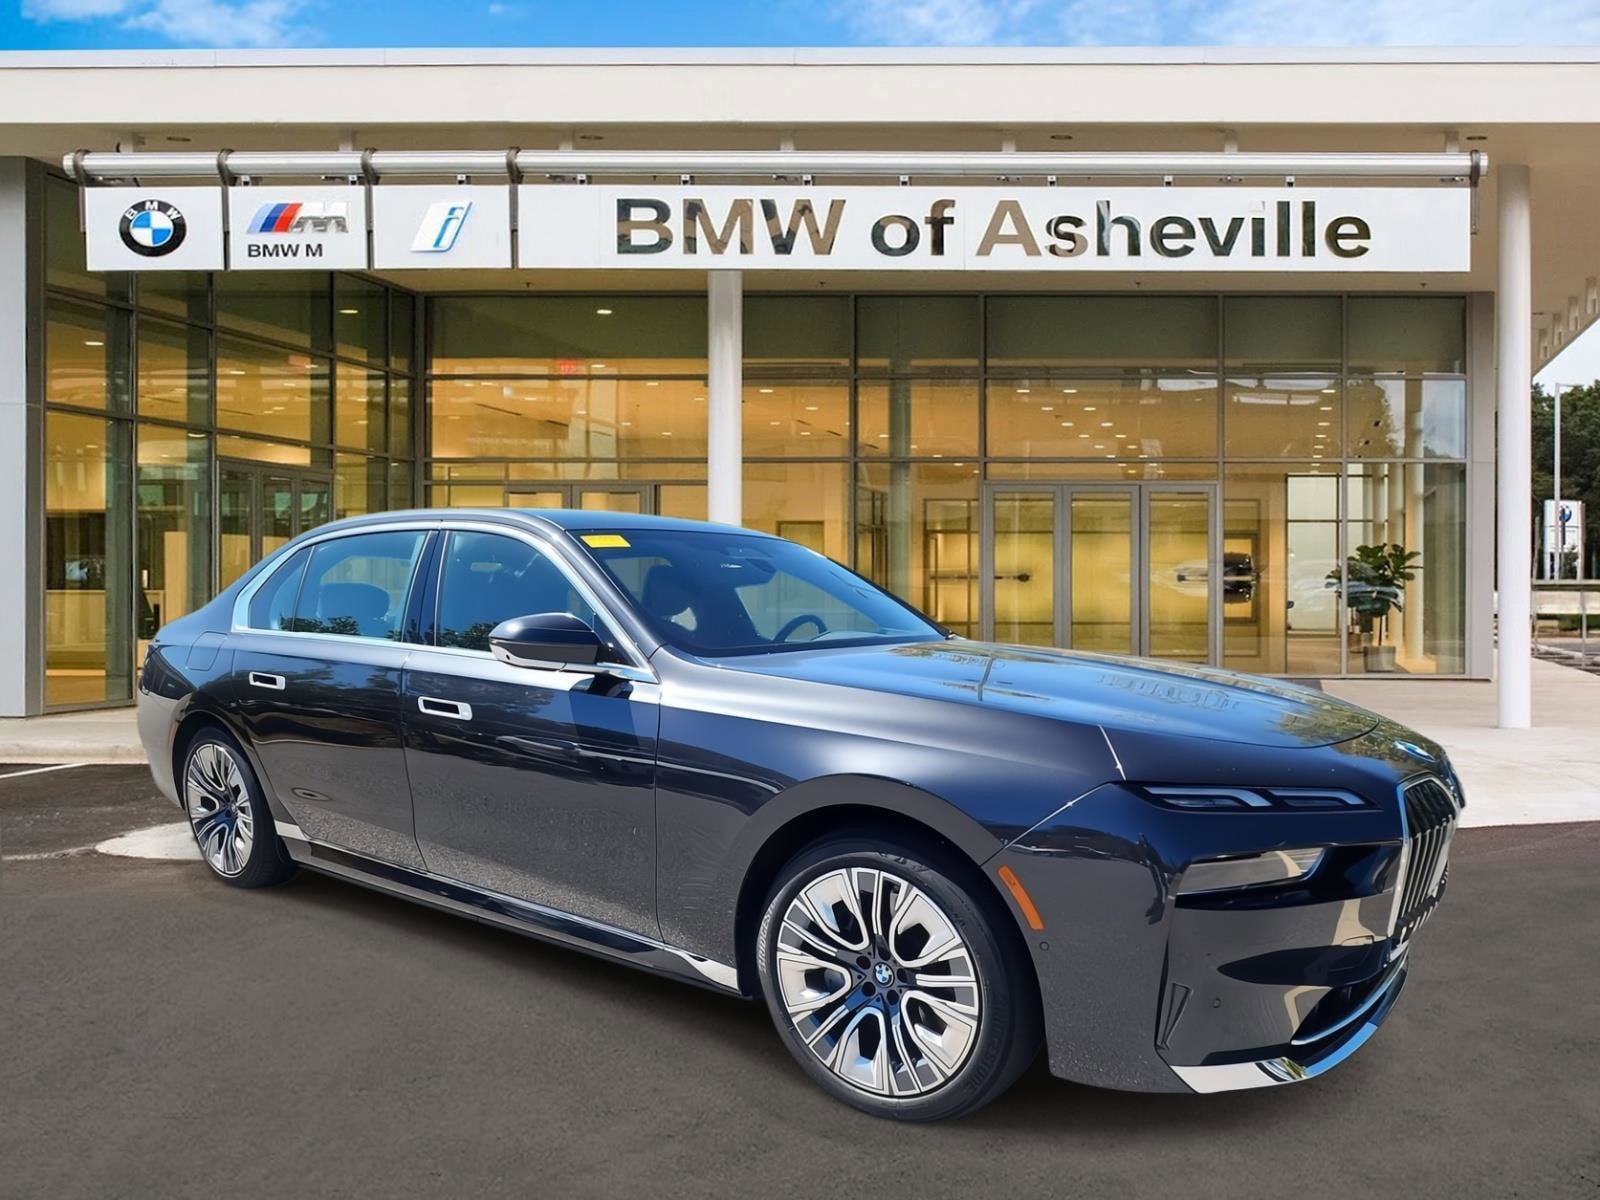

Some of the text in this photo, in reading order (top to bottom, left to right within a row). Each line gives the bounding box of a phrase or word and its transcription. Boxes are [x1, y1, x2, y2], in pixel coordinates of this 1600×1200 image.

[616, 198, 1372, 258] BMW of Asheville
[247, 243, 323, 258] BMW M
